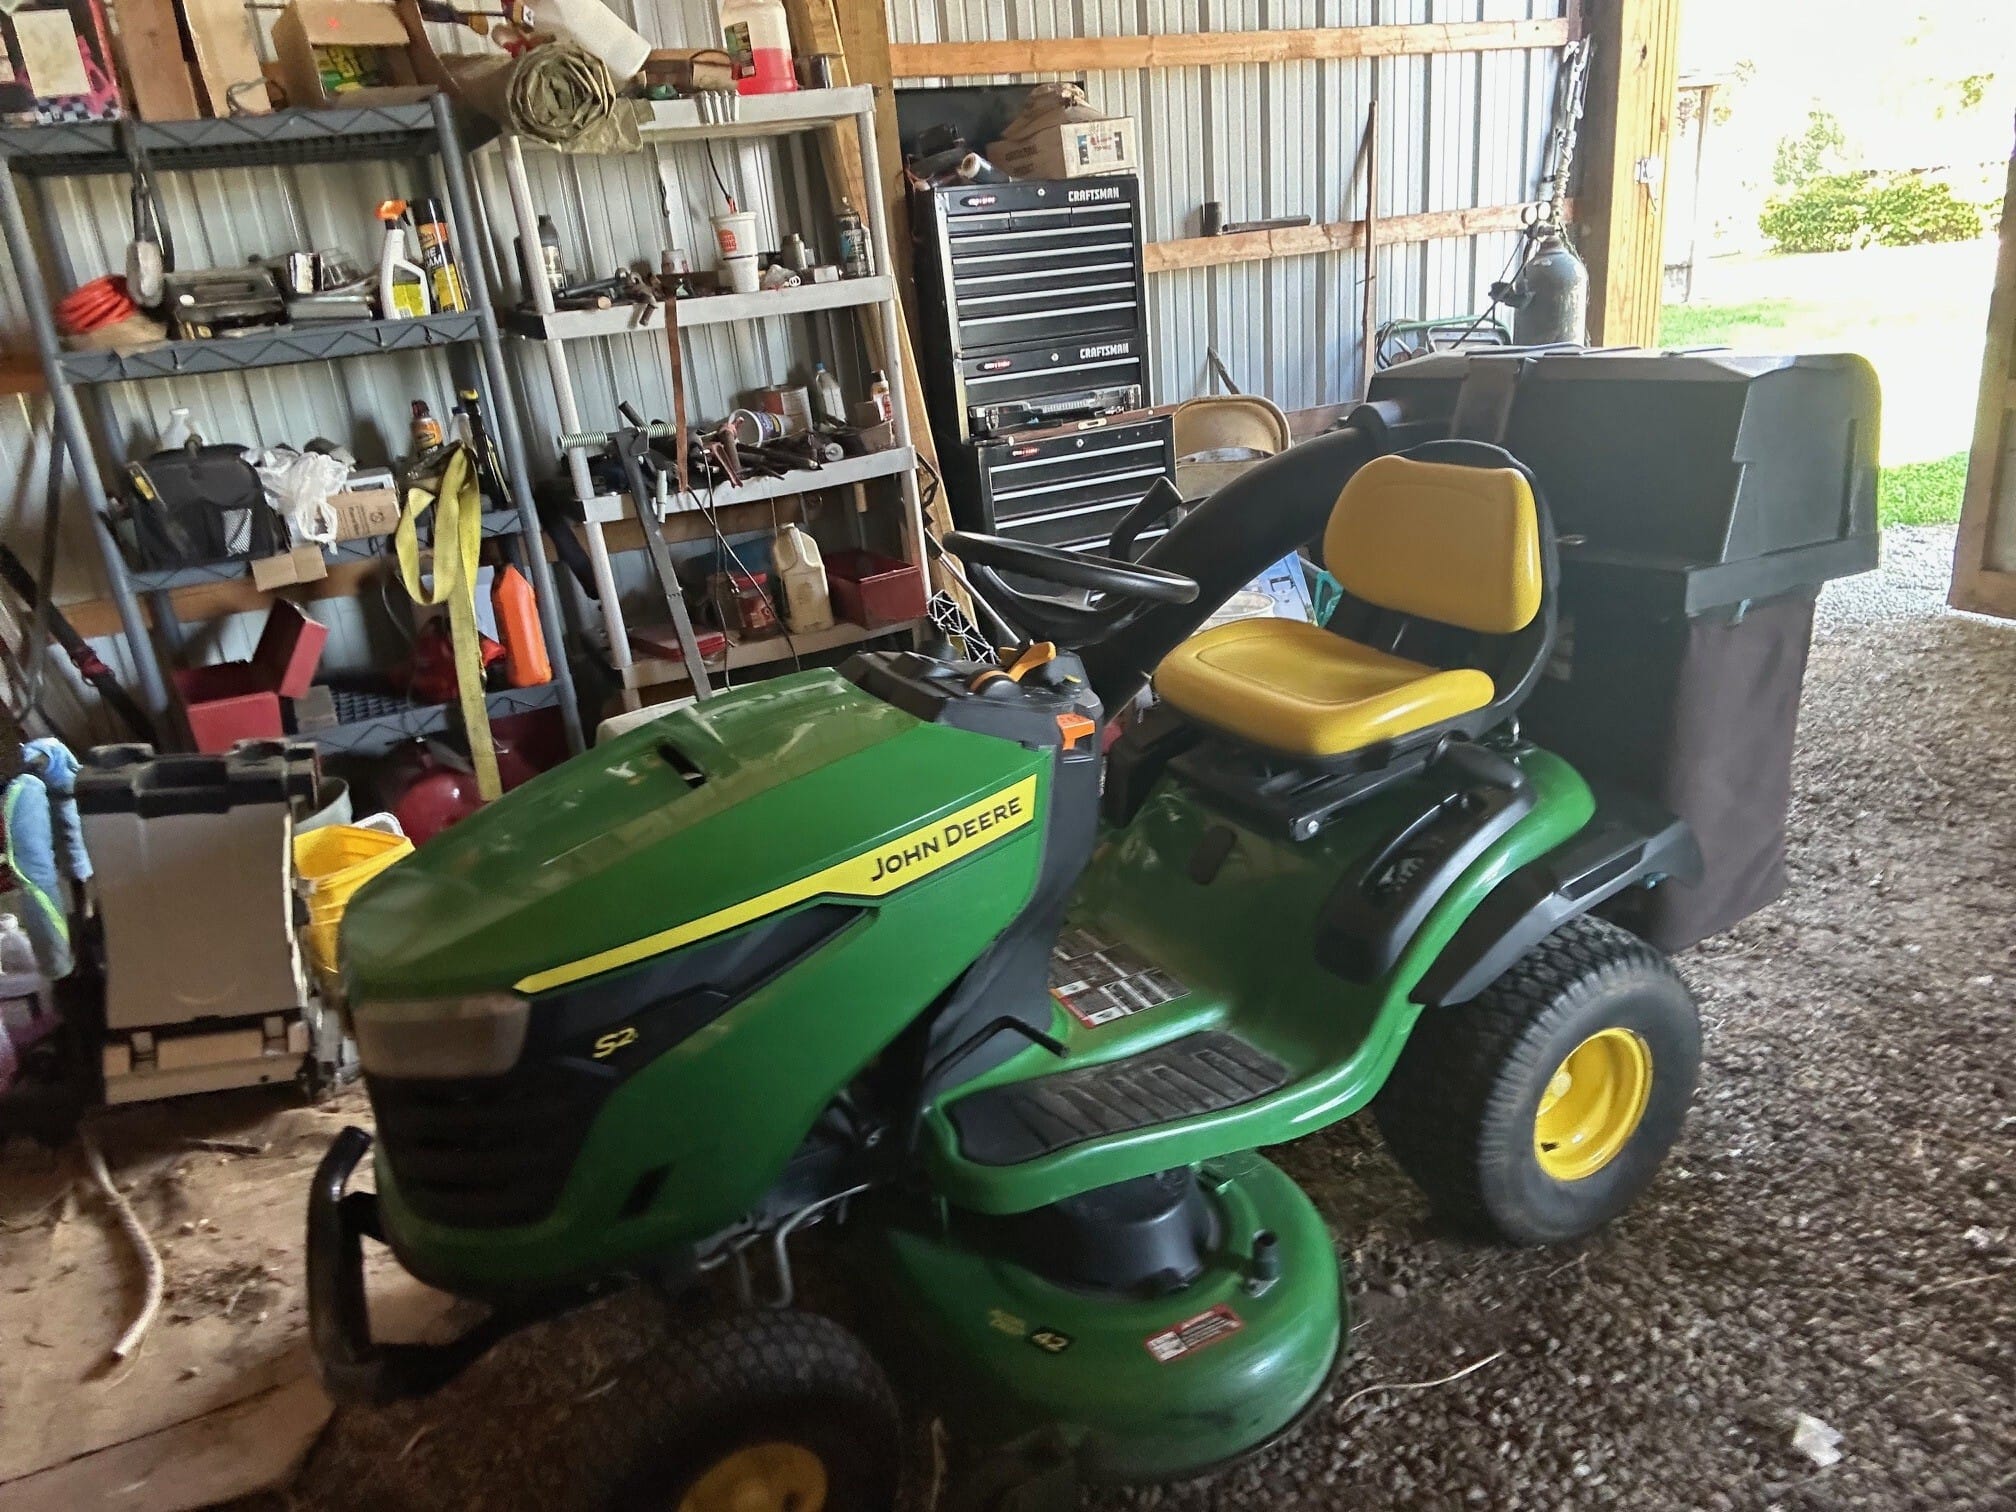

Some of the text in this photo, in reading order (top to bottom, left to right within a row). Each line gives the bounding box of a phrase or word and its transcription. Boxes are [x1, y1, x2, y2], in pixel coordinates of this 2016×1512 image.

[1068, 187, 1120, 202] CRAFTSMAN
[1079, 343, 1129, 359] CRAFTSMAN
[871, 797, 1022, 882] JOHN DEERE
